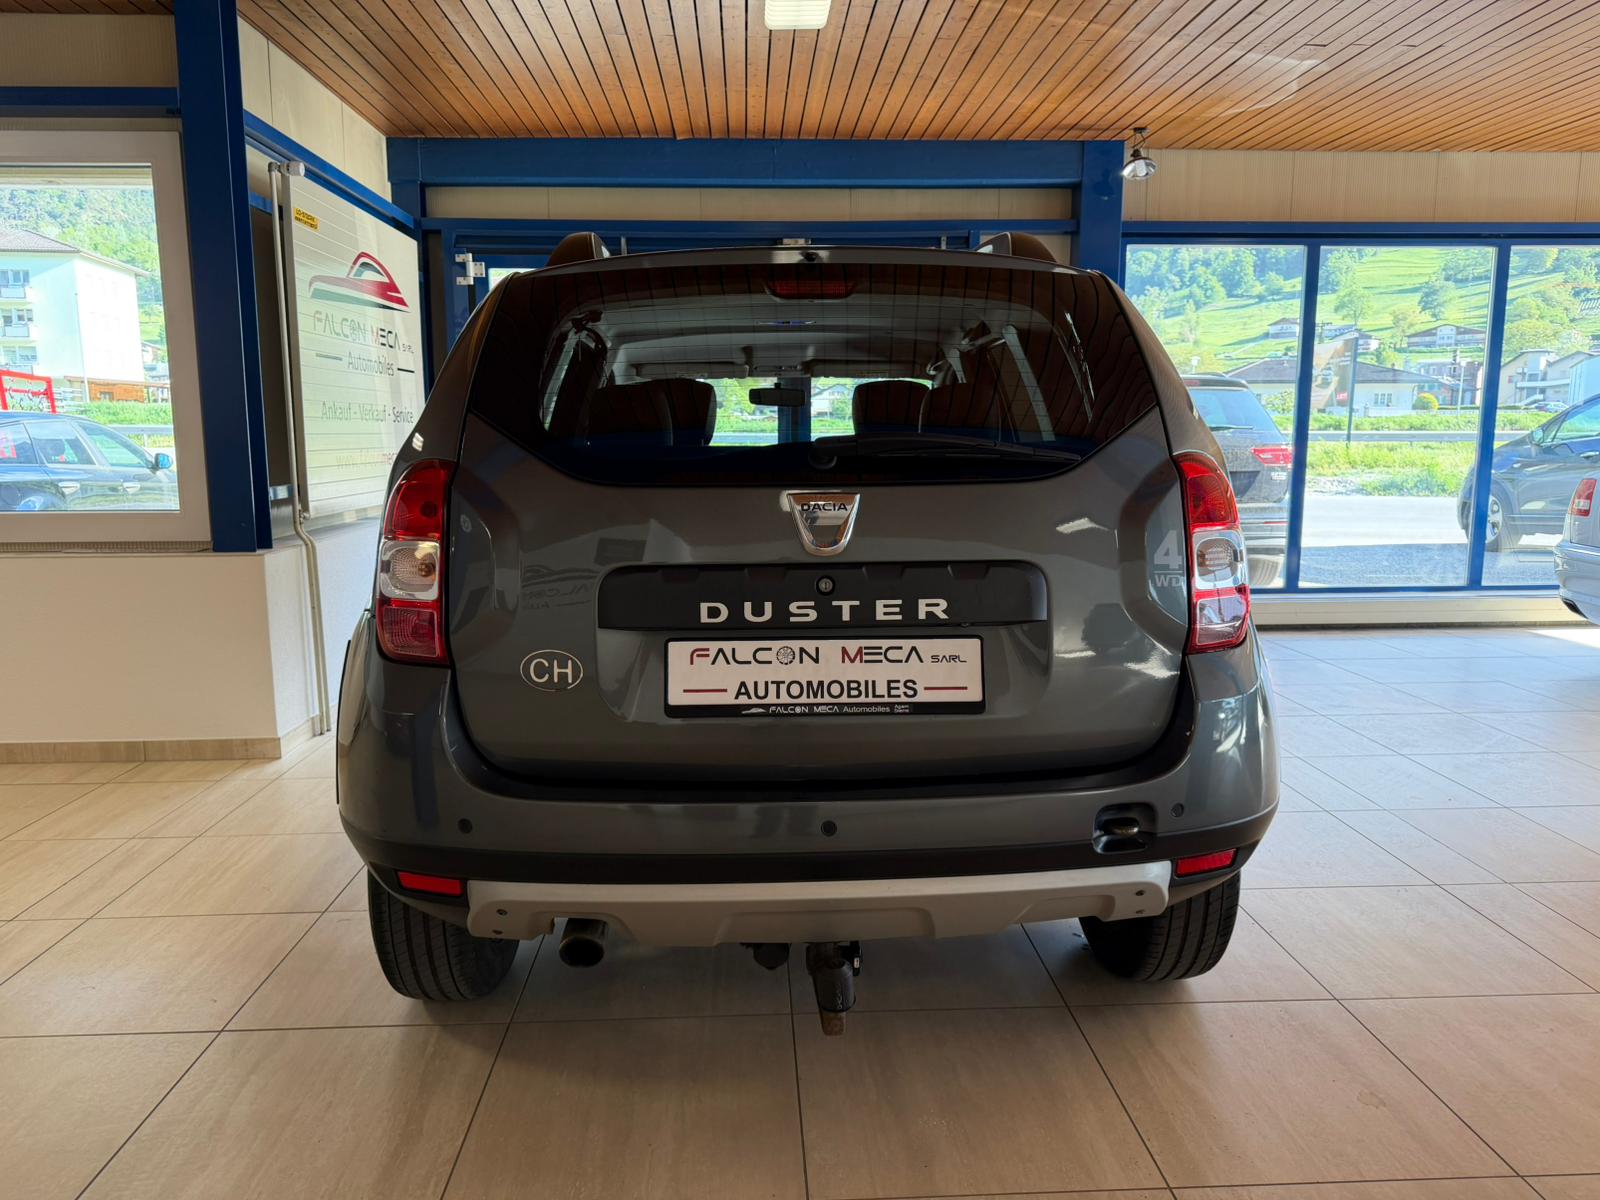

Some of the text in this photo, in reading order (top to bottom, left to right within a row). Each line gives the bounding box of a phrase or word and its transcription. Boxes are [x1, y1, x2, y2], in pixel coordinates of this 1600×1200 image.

[313, 310, 367, 343] FALCON
[370, 325, 401, 351] MECA
[347, 351, 395, 376] Automobiles
[321, 400, 414, 424] Ankauf Verkauf Service
[801, 502, 848, 512] DACIA
[1154, 530, 1182, 569] 4
[1155, 574, 1183, 587] WD
[700, 598, 949, 624] DUSTER
[690, 645, 968, 666] FALCON MECA SARL
[529, 658, 573, 684] CH
[734, 679, 919, 701] AUTOMOBILES
[769, 705, 809, 715] FALCON
[813, 705, 839, 714] MECA
[843, 704, 890, 714] Automobiles
